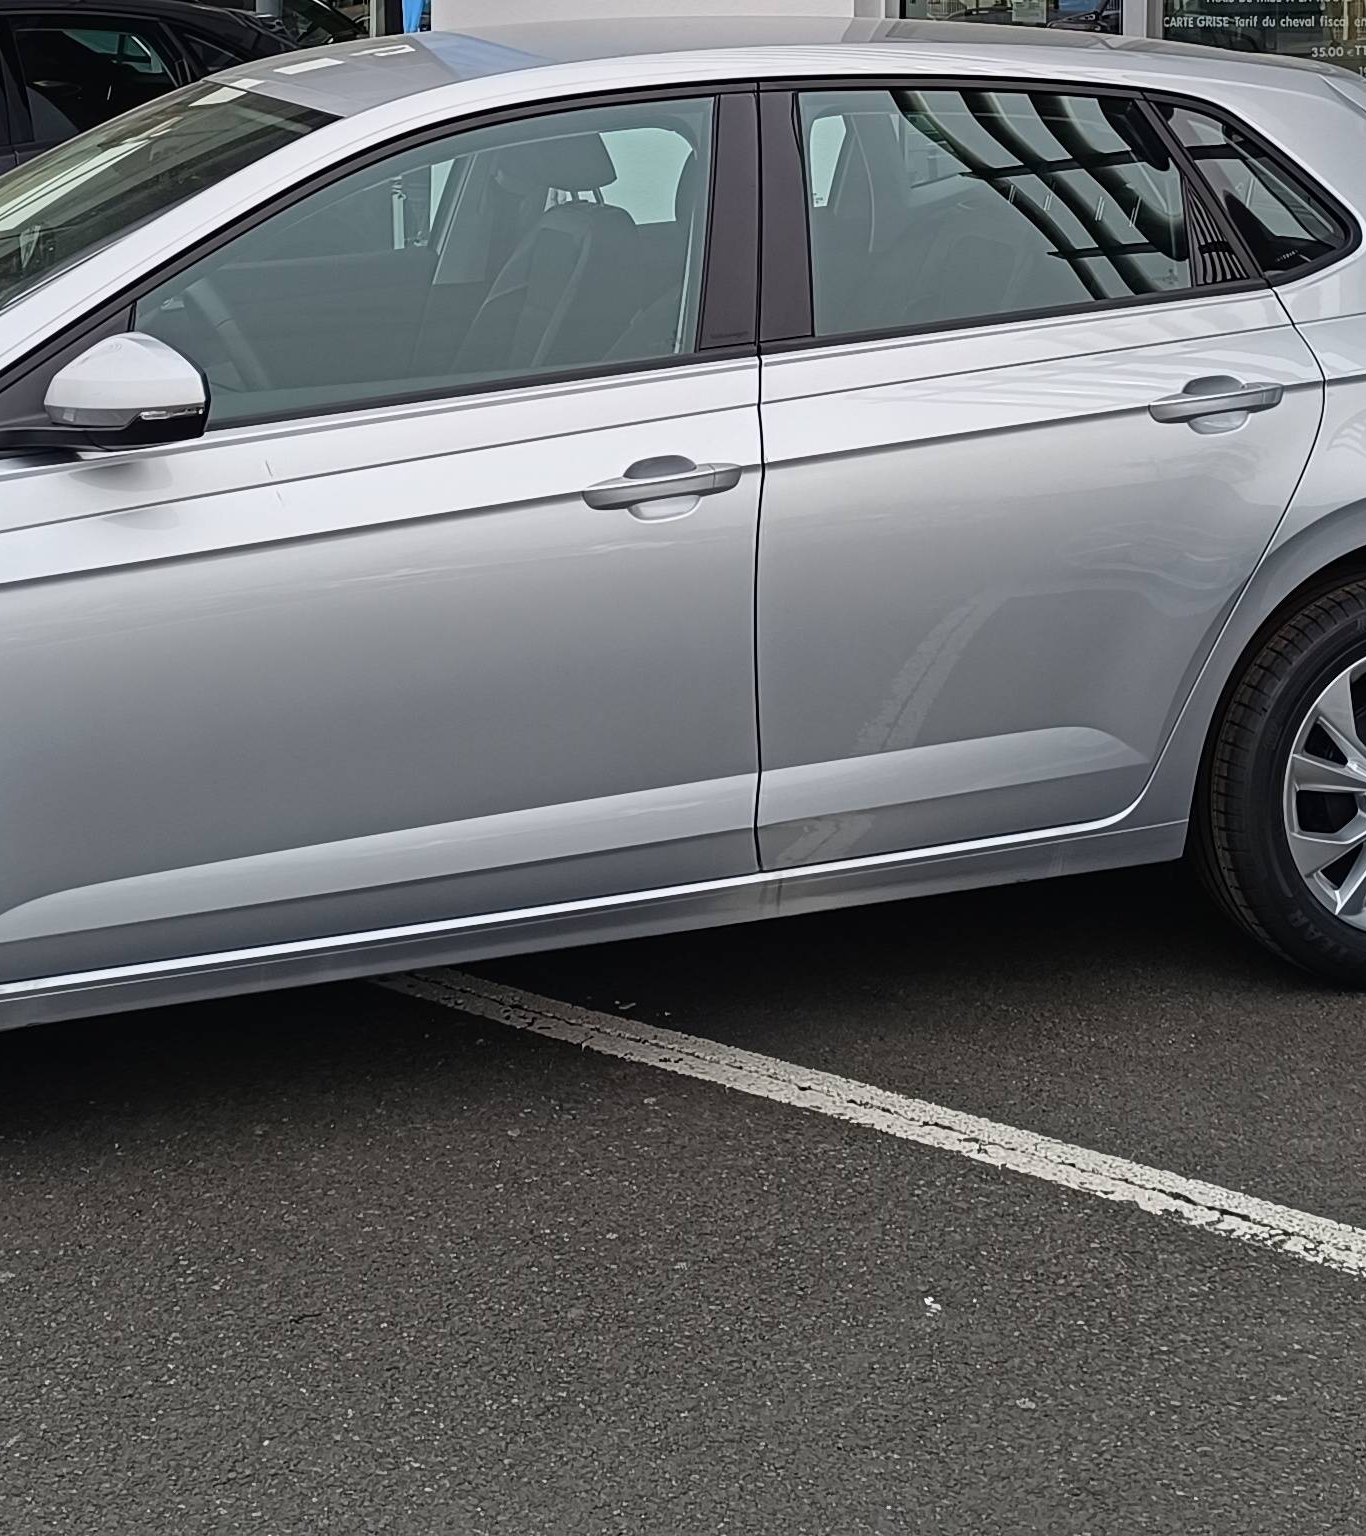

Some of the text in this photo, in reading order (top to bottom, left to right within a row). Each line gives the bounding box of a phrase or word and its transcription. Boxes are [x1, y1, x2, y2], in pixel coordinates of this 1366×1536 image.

[1163, 17, 1194, 28] CARTE
[1197, 17, 1229, 28] GRISE
[1234, 16, 1258, 28] Tarif
[1262, 16, 1276, 28] du
[1280, 15, 1315, 28] cheval
[1319, 15, 1348, 28] fiscal
[1311, 46, 1344, 58] 35.00
